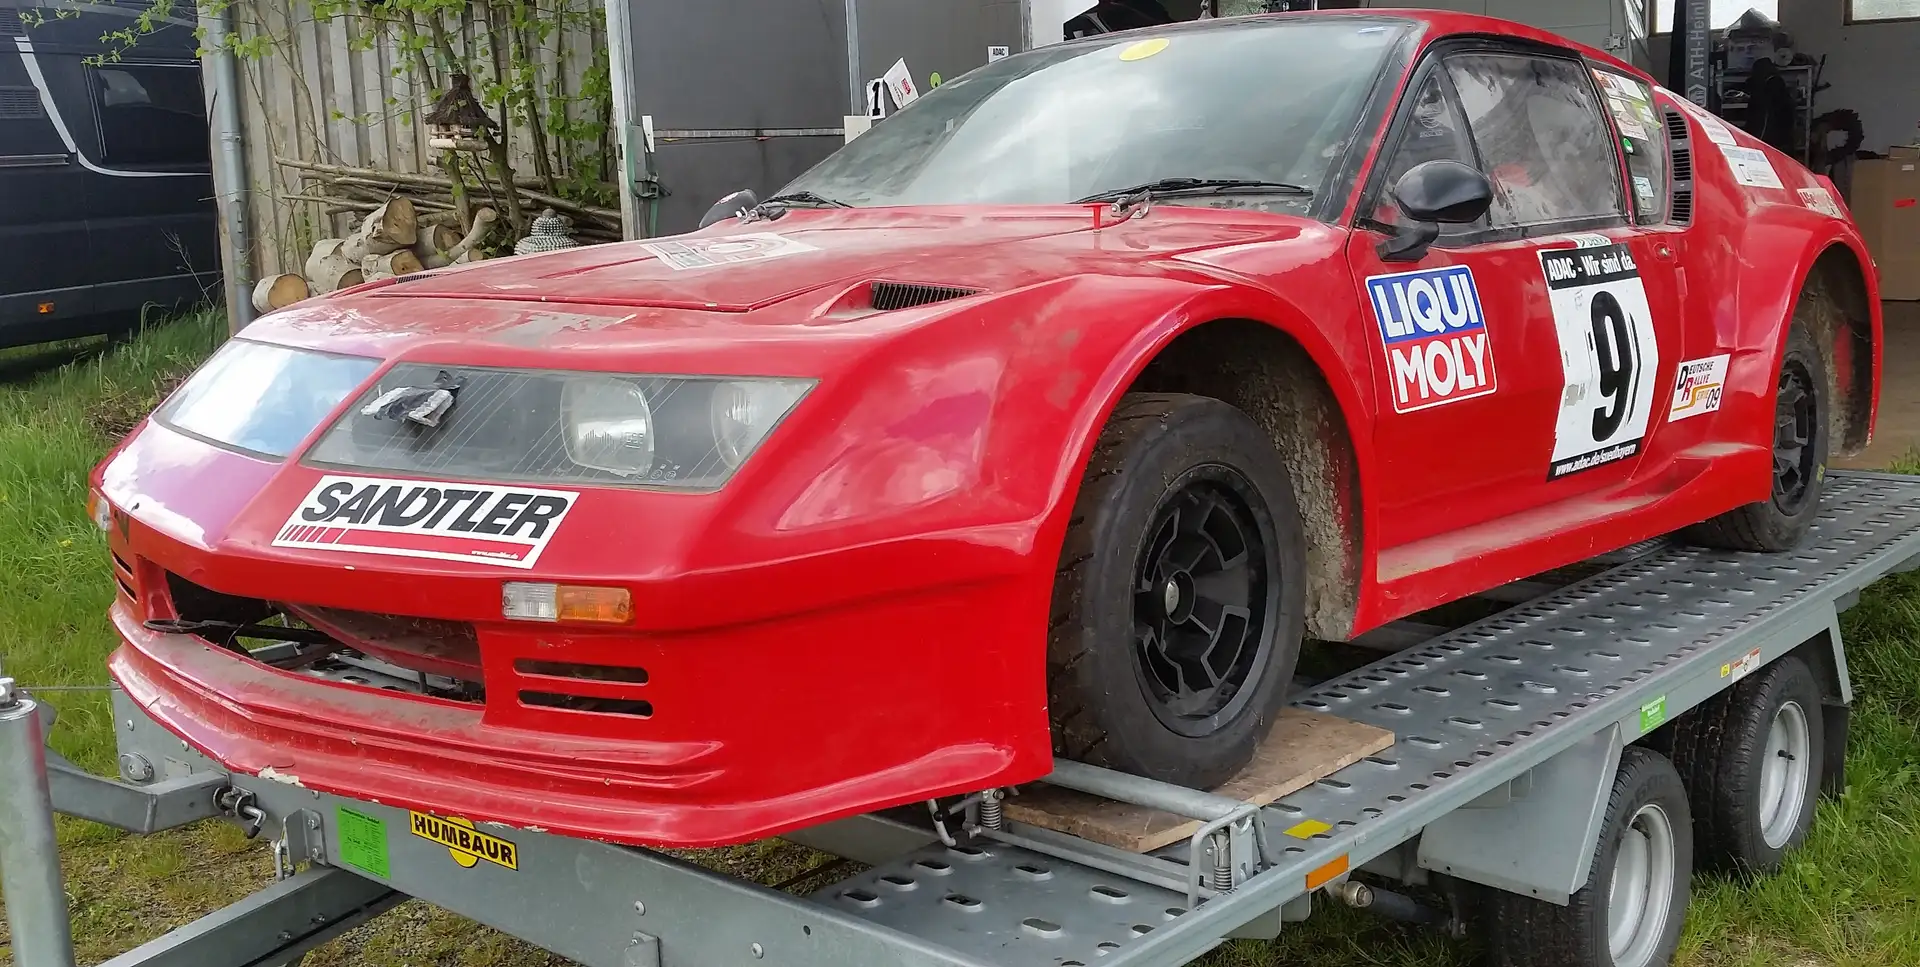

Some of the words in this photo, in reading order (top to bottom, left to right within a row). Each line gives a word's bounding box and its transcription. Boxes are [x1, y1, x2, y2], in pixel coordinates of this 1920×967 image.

[1690, 1, 1705, 80] ATH-Heinl
[1547, 257, 1577, 281] ADAC
[1581, 254, 1601, 276] Wir
[1601, 251, 1622, 274] sind
[1620, 250, 1637, 271] da.
[1373, 272, 1480, 338] LIQUI
[1391, 333, 1487, 404] MOLY
[1590, 290, 1633, 443] 9
[1554, 443, 1637, 477] www.adac.de/suedbayern
[300, 481, 569, 539] SANDTLER
[413, 814, 514, 866] HUMBAUR
